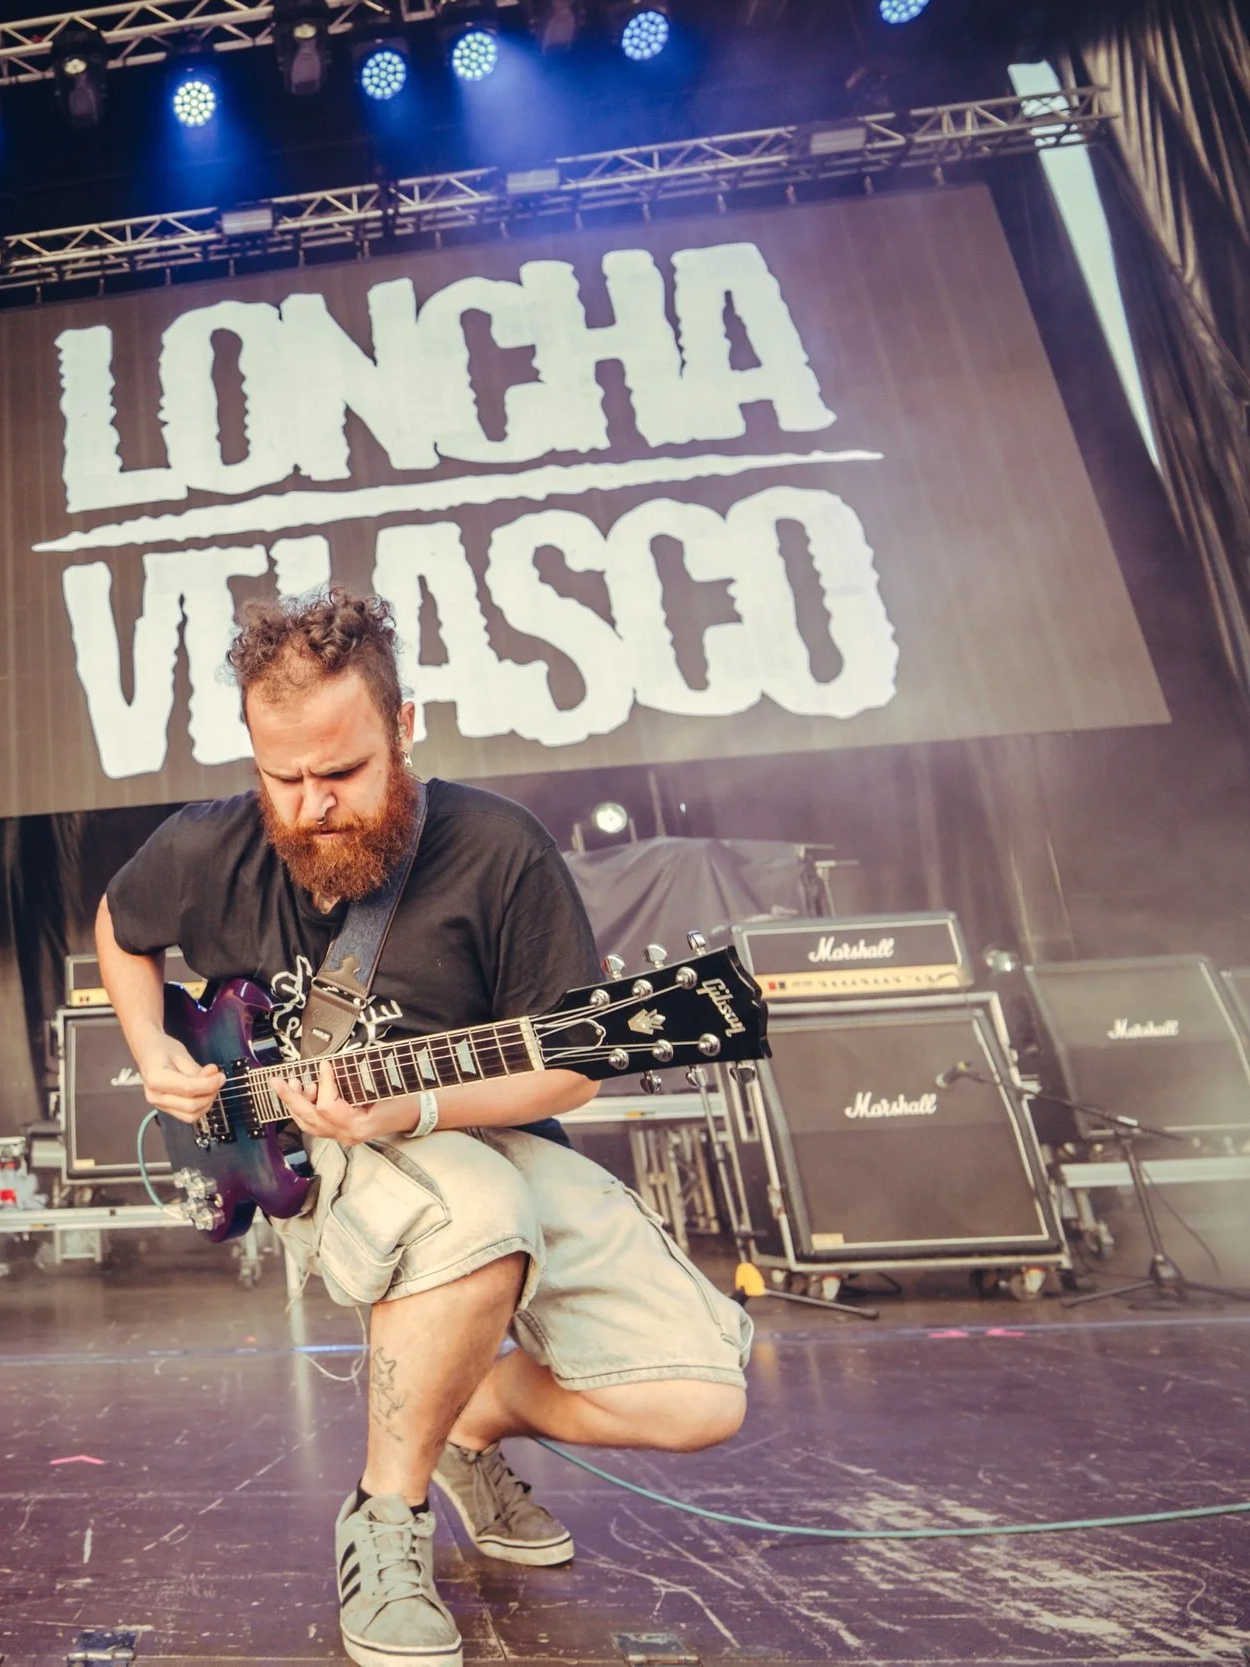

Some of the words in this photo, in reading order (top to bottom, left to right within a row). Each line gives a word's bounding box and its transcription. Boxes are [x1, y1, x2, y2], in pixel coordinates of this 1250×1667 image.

[55, 243, 838, 513] LONCHA
[808, 936, 894, 963] Marshall
[696, 978, 746, 1037] Gibson
[844, 1091, 937, 1118] Marshall
